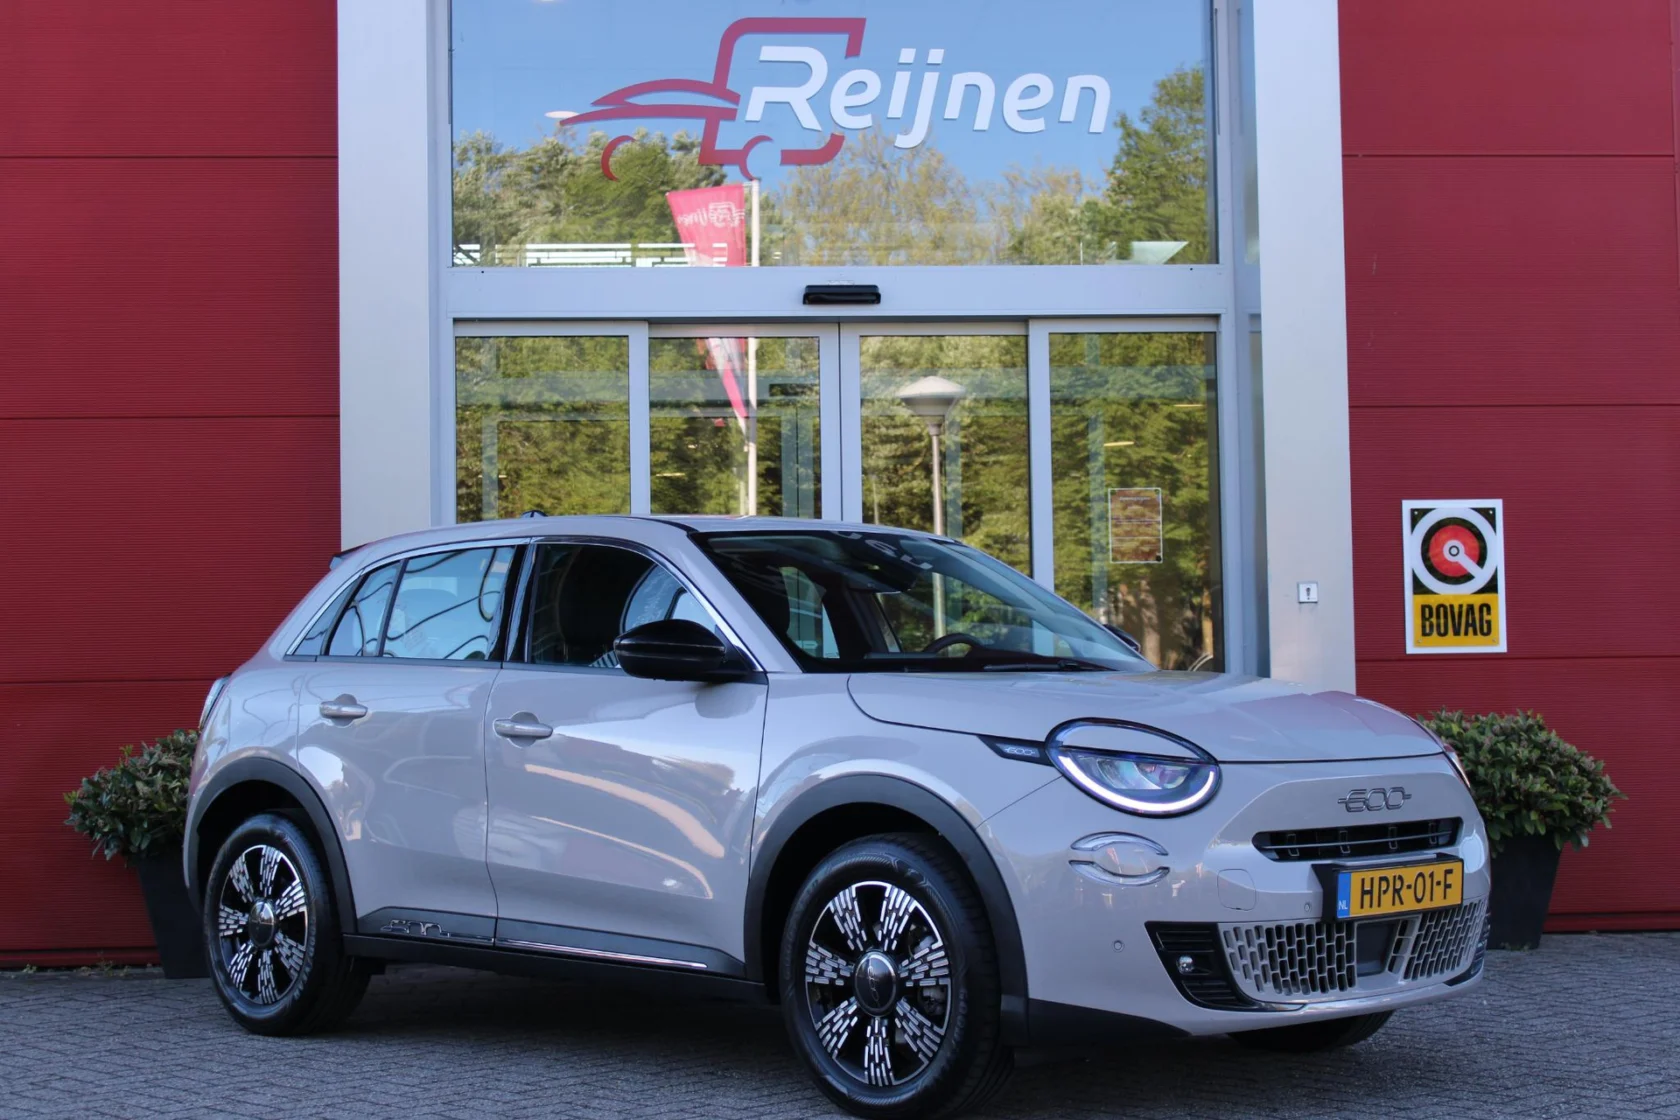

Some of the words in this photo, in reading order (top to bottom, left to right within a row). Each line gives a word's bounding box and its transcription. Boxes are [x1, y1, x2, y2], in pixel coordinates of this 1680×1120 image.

[745, 45, 1111, 149] Reijnen
[1420, 603, 1492, 637] BOVAG
[1339, 786, 1411, 813] 600
[1338, 900, 1349, 911] NL
[1359, 868, 1454, 909] HPR-01-F
